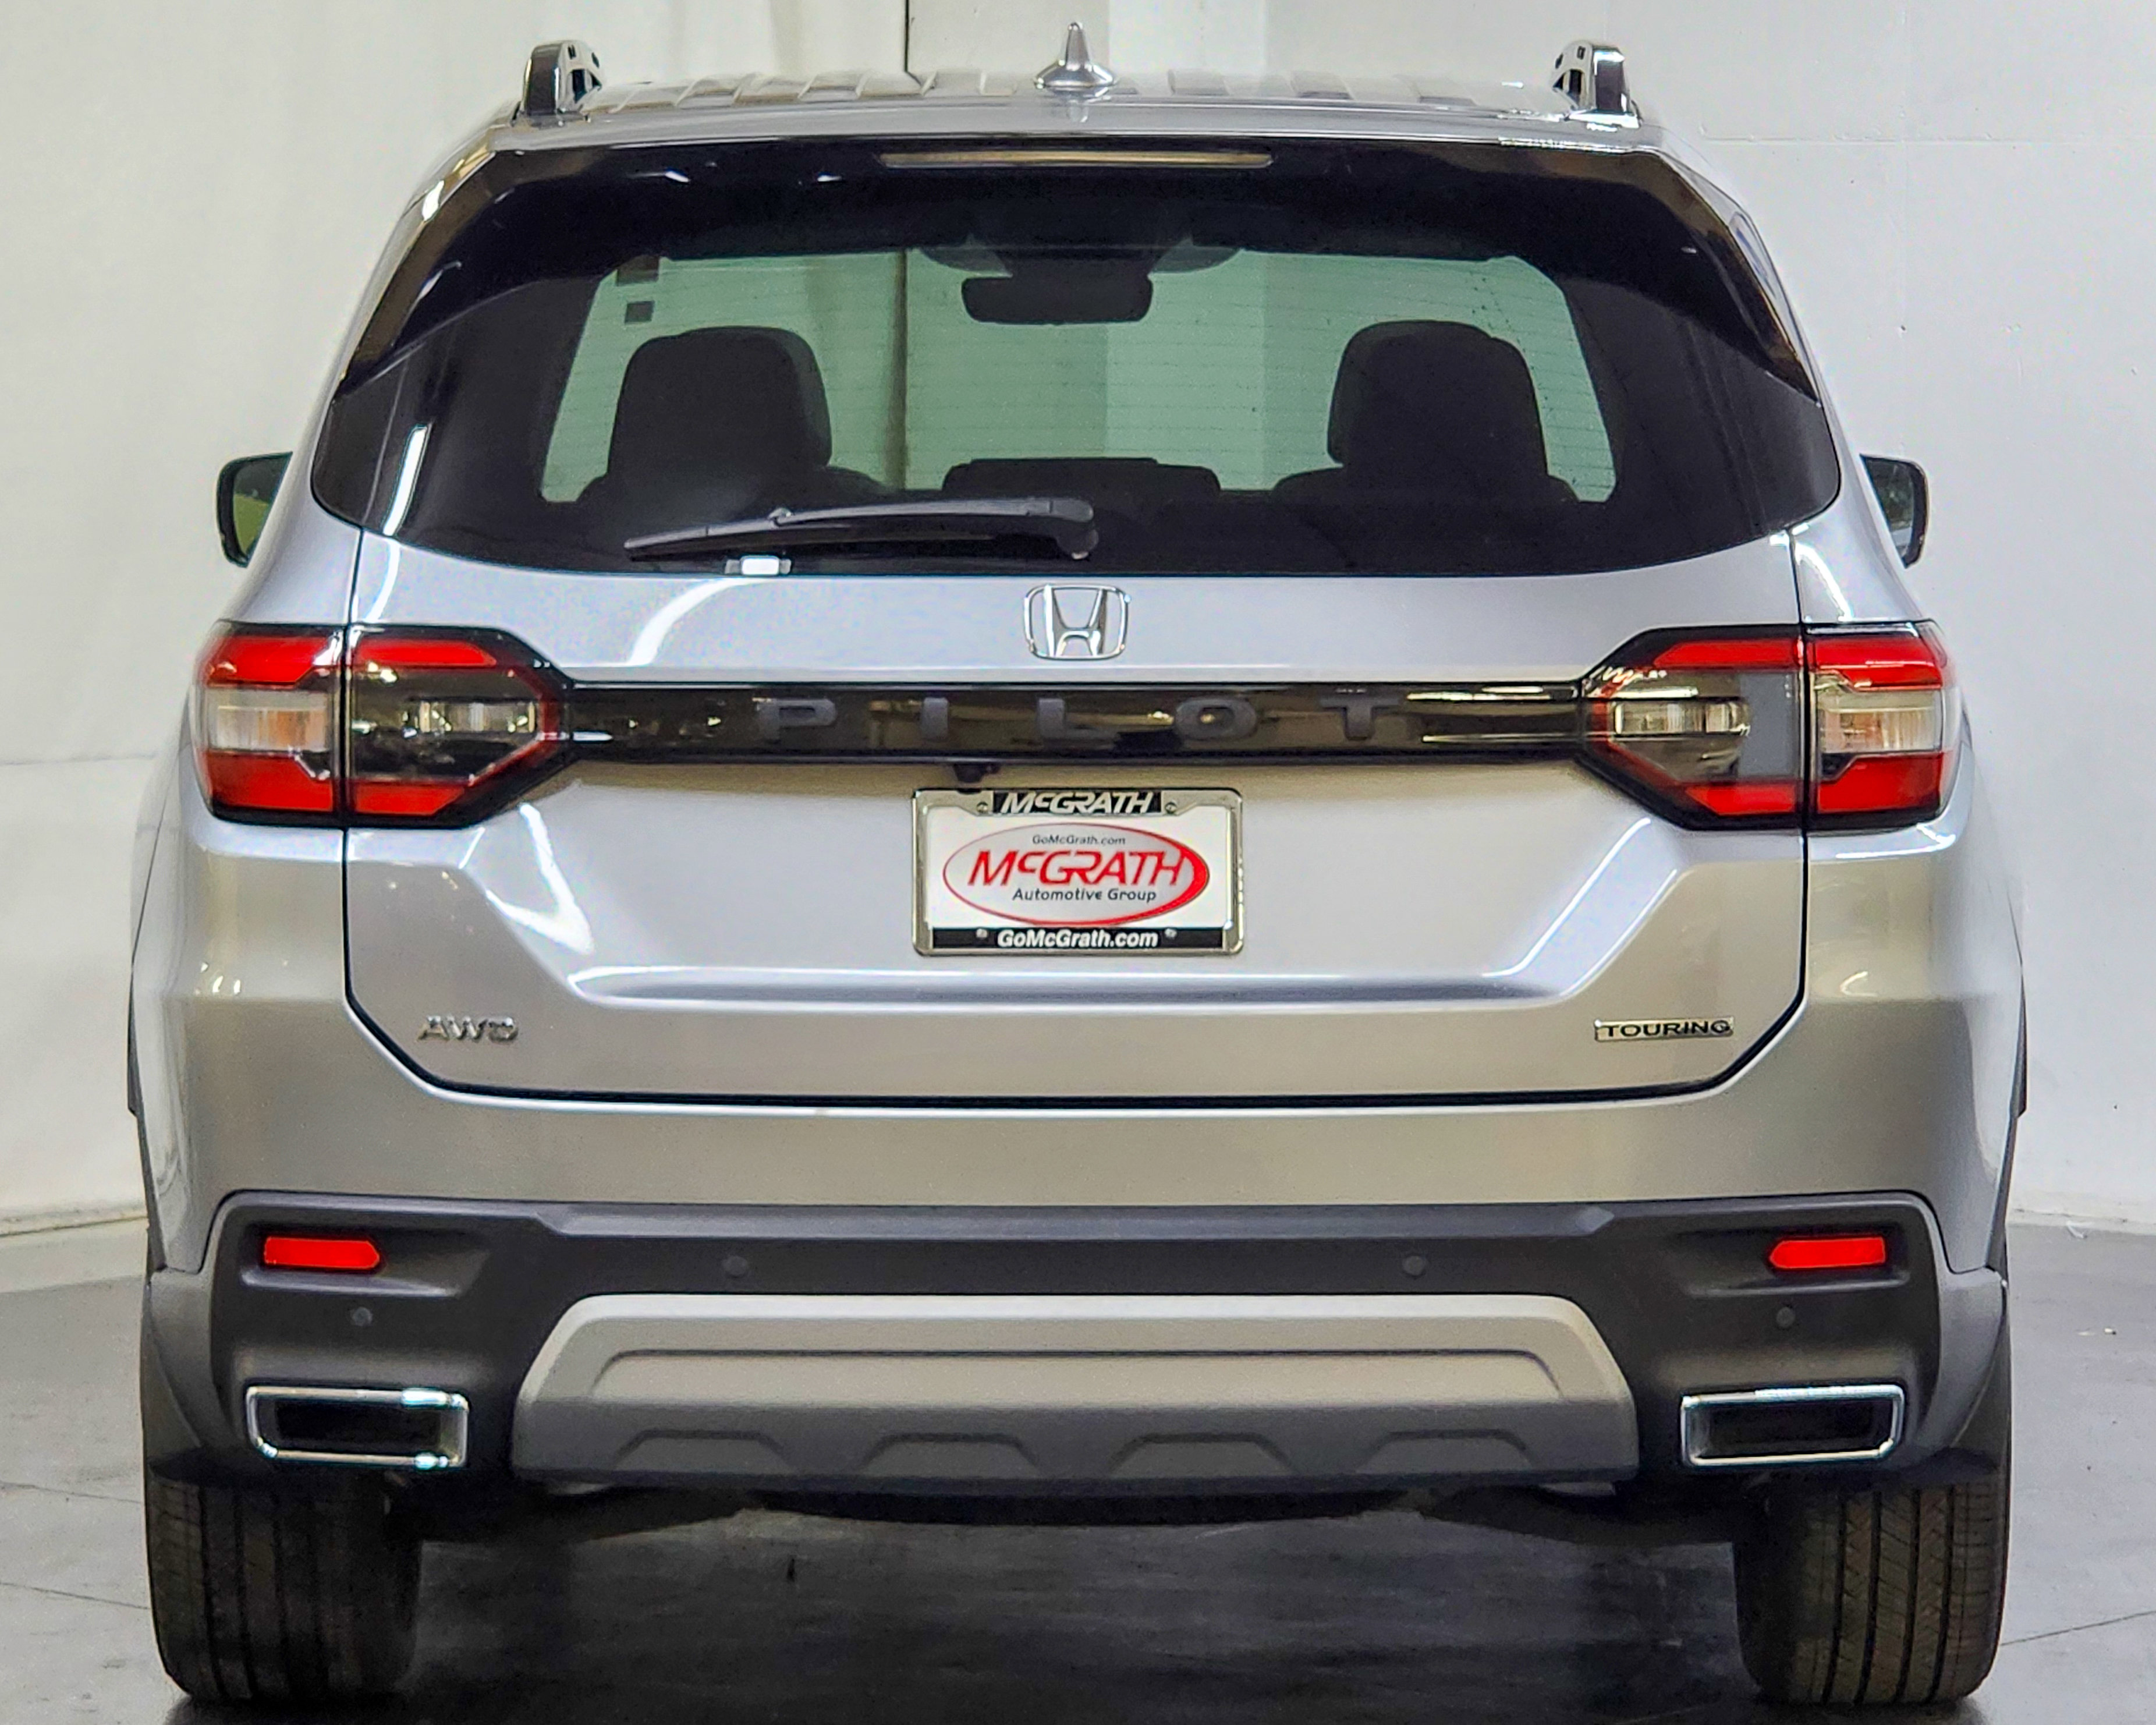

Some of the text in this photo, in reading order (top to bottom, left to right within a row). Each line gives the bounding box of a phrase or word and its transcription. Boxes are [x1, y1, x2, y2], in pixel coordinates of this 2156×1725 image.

[758, 697, 1404, 742] PILOT
[1033, 834, 1126, 846] GoMcGrath.com
[1012, 888, 1157, 904] Automotive Group
[997, 930, 1158, 949] GoMcGrath.com
[417, 1015, 519, 1043] AWD
[1603, 1019, 1731, 1037] TOURING
